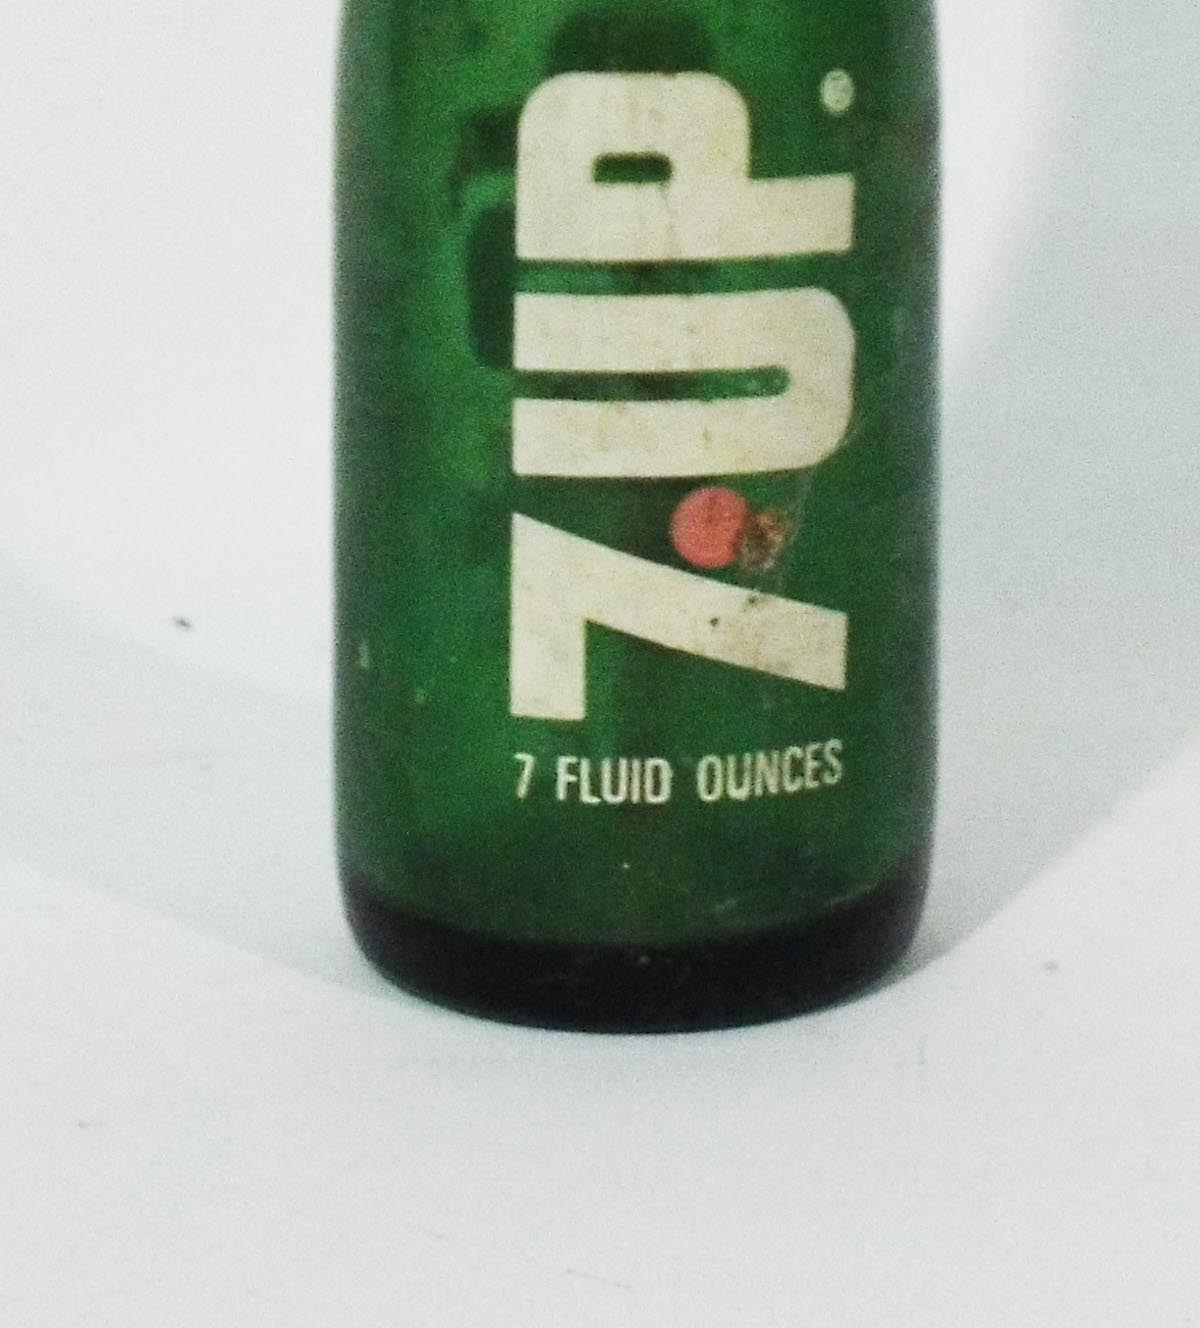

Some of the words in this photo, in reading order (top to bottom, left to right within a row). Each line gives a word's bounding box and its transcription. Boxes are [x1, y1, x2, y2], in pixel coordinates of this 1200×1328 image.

[514, 753, 535, 800] 7
[556, 755, 673, 804] FLUID
[696, 738, 843, 802] OUNCES
